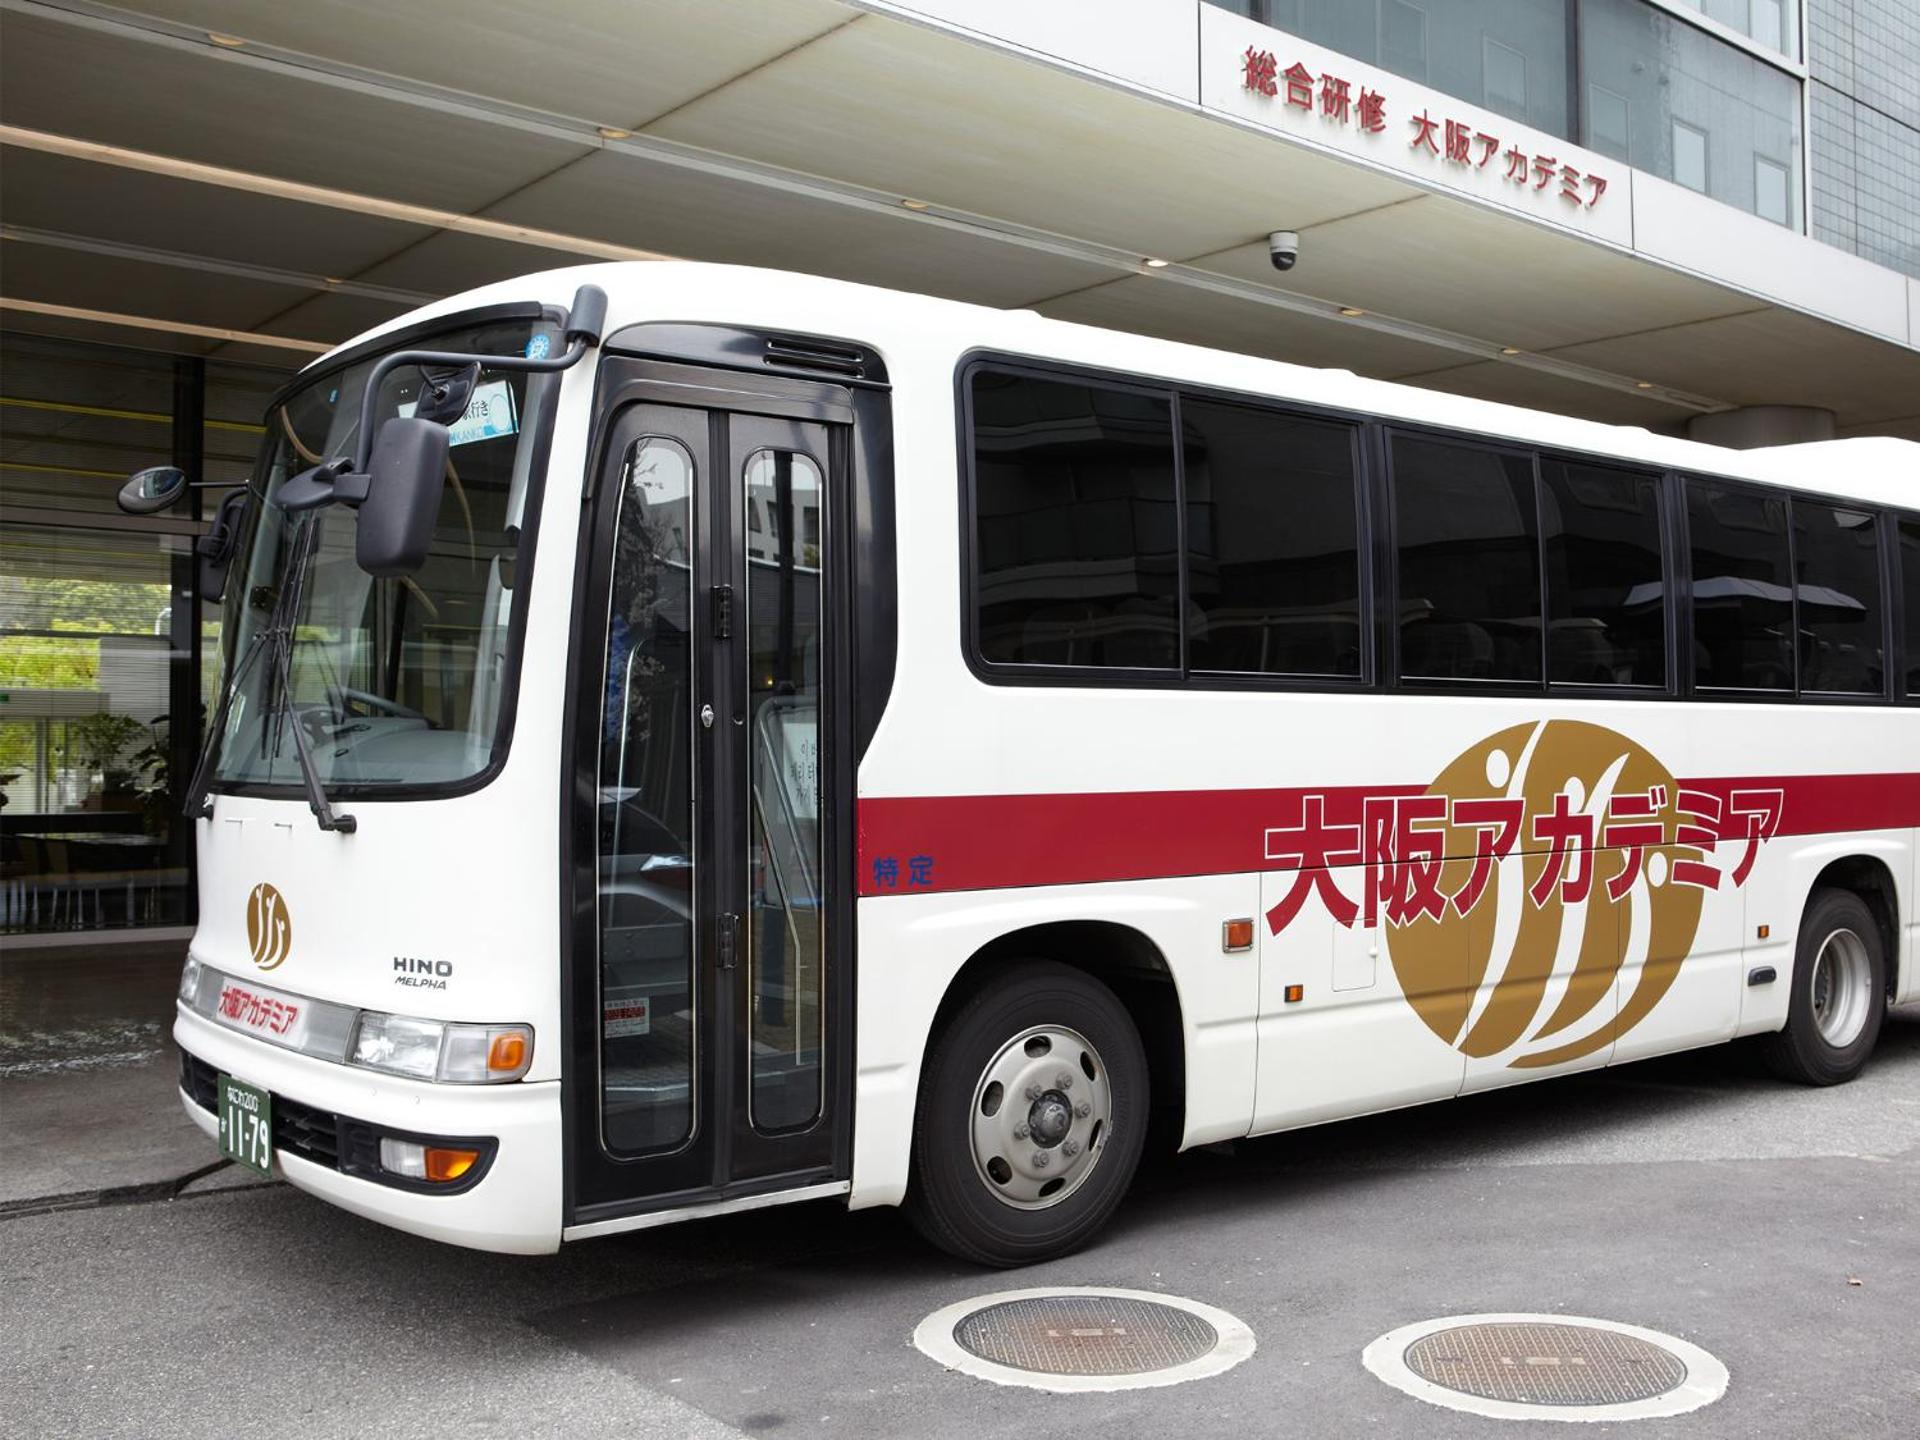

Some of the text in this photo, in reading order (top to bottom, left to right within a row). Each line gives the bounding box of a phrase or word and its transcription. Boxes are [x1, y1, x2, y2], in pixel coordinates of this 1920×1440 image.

[1241, 45, 1607, 207] 総合研修 大阪アカデミア
[1264, 785, 1784, 937] 大阪アカデミア
[393, 956, 453, 977] HINO
[394, 975, 447, 990] MELPHA
[219, 985, 299, 1035] 大阪アカデミア
